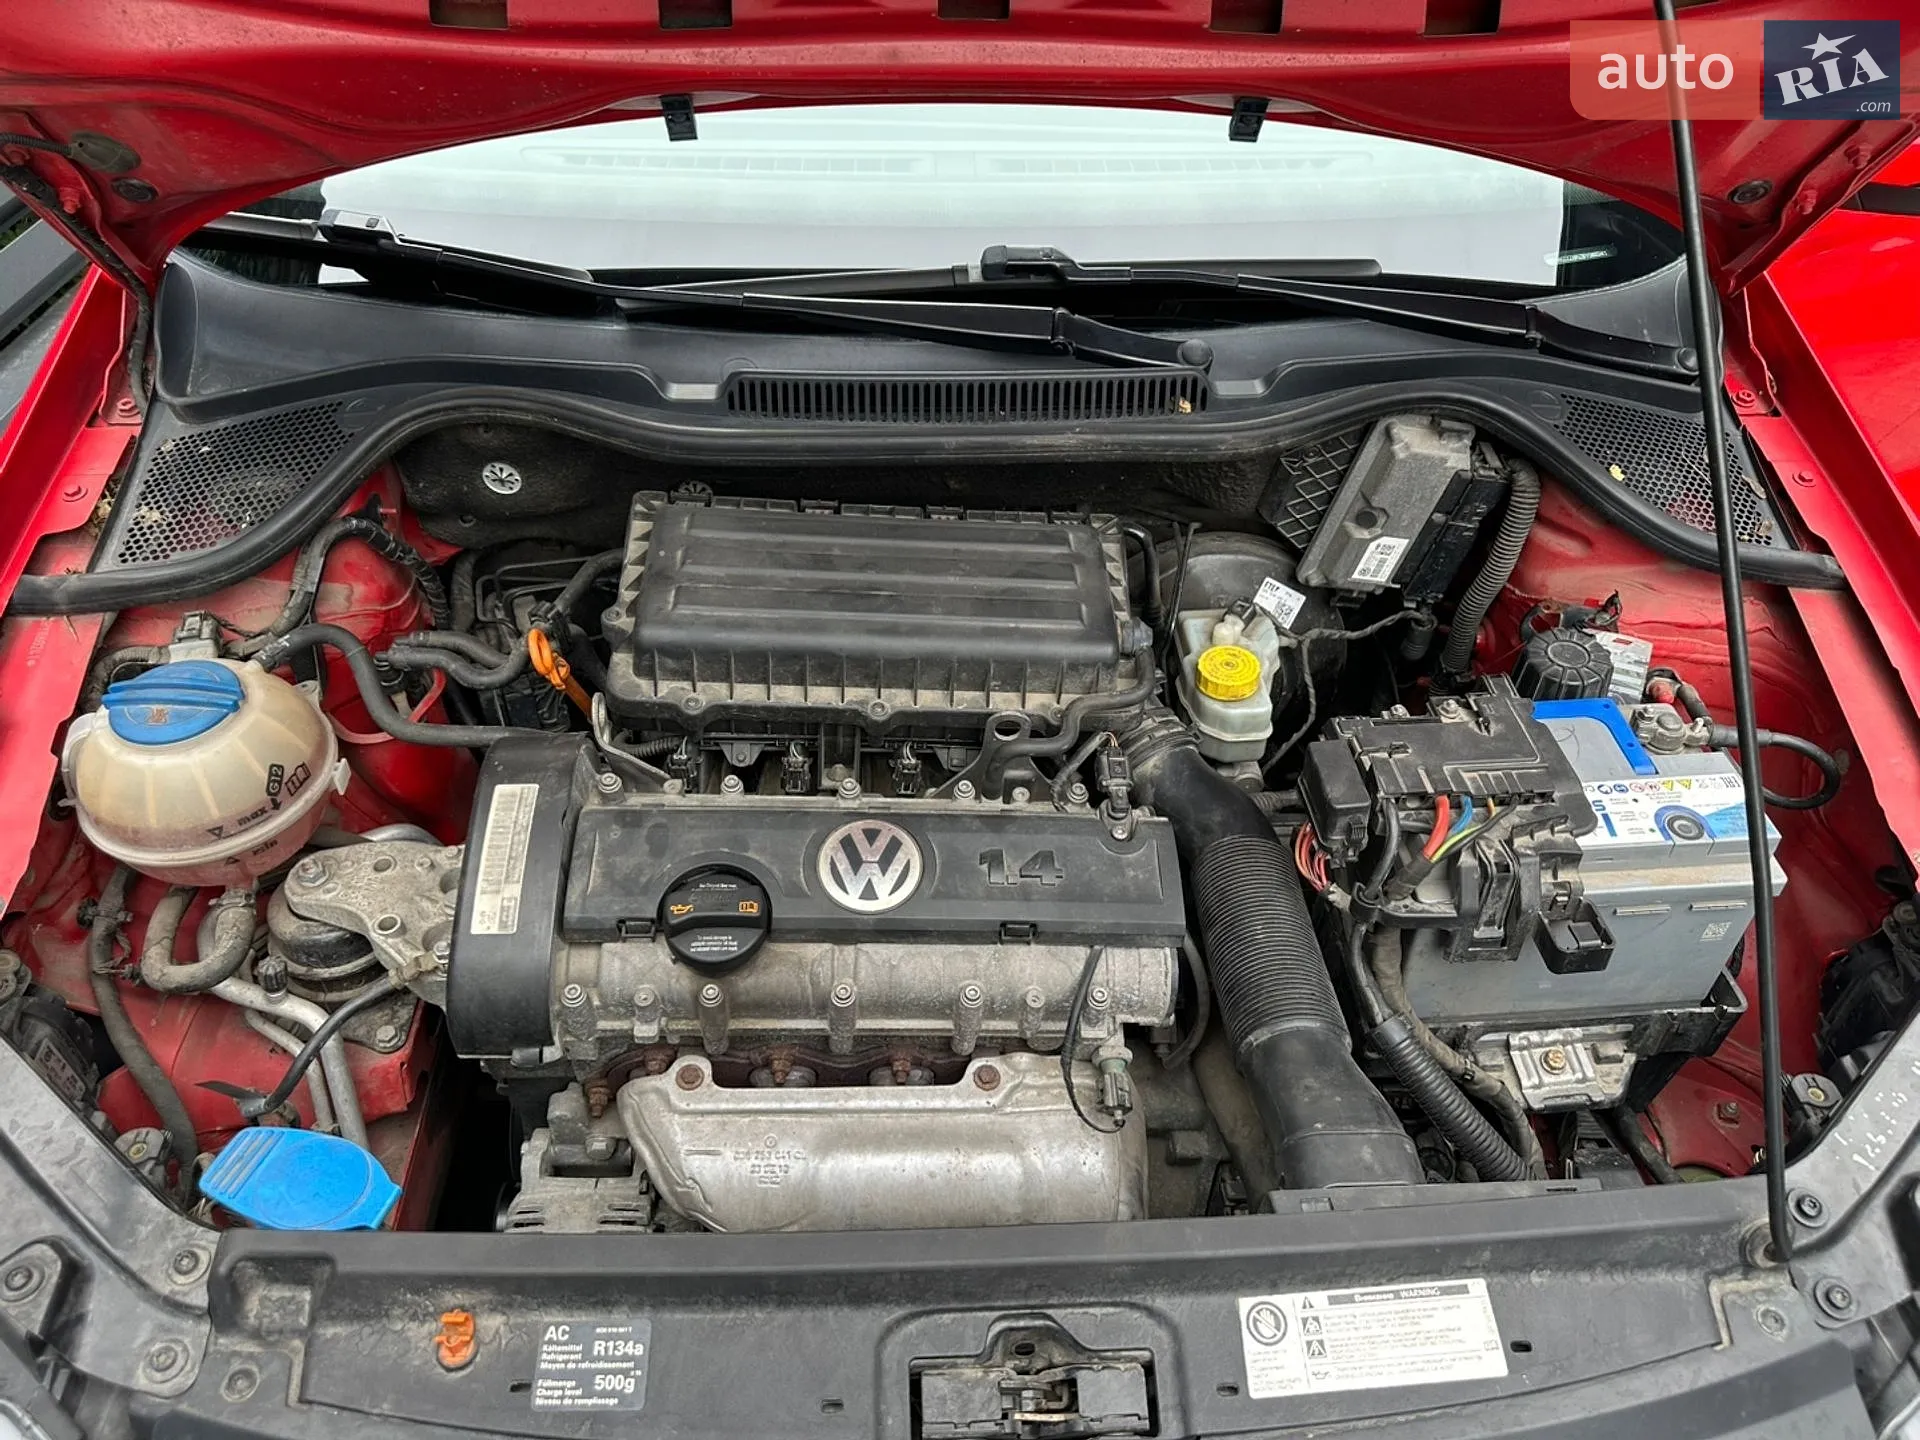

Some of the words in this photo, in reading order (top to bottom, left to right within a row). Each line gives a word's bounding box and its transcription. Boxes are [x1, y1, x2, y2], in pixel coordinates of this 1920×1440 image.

[269, 766, 283, 793] G12
[237, 806, 268, 826] max
[978, 849, 1064, 886] 1.4
[1400, 1287, 1441, 1299] WARNING
[544, 1325, 570, 1341] AC
[593, 1340, 644, 1356] R134a
[594, 1374, 636, 1394] 500g
